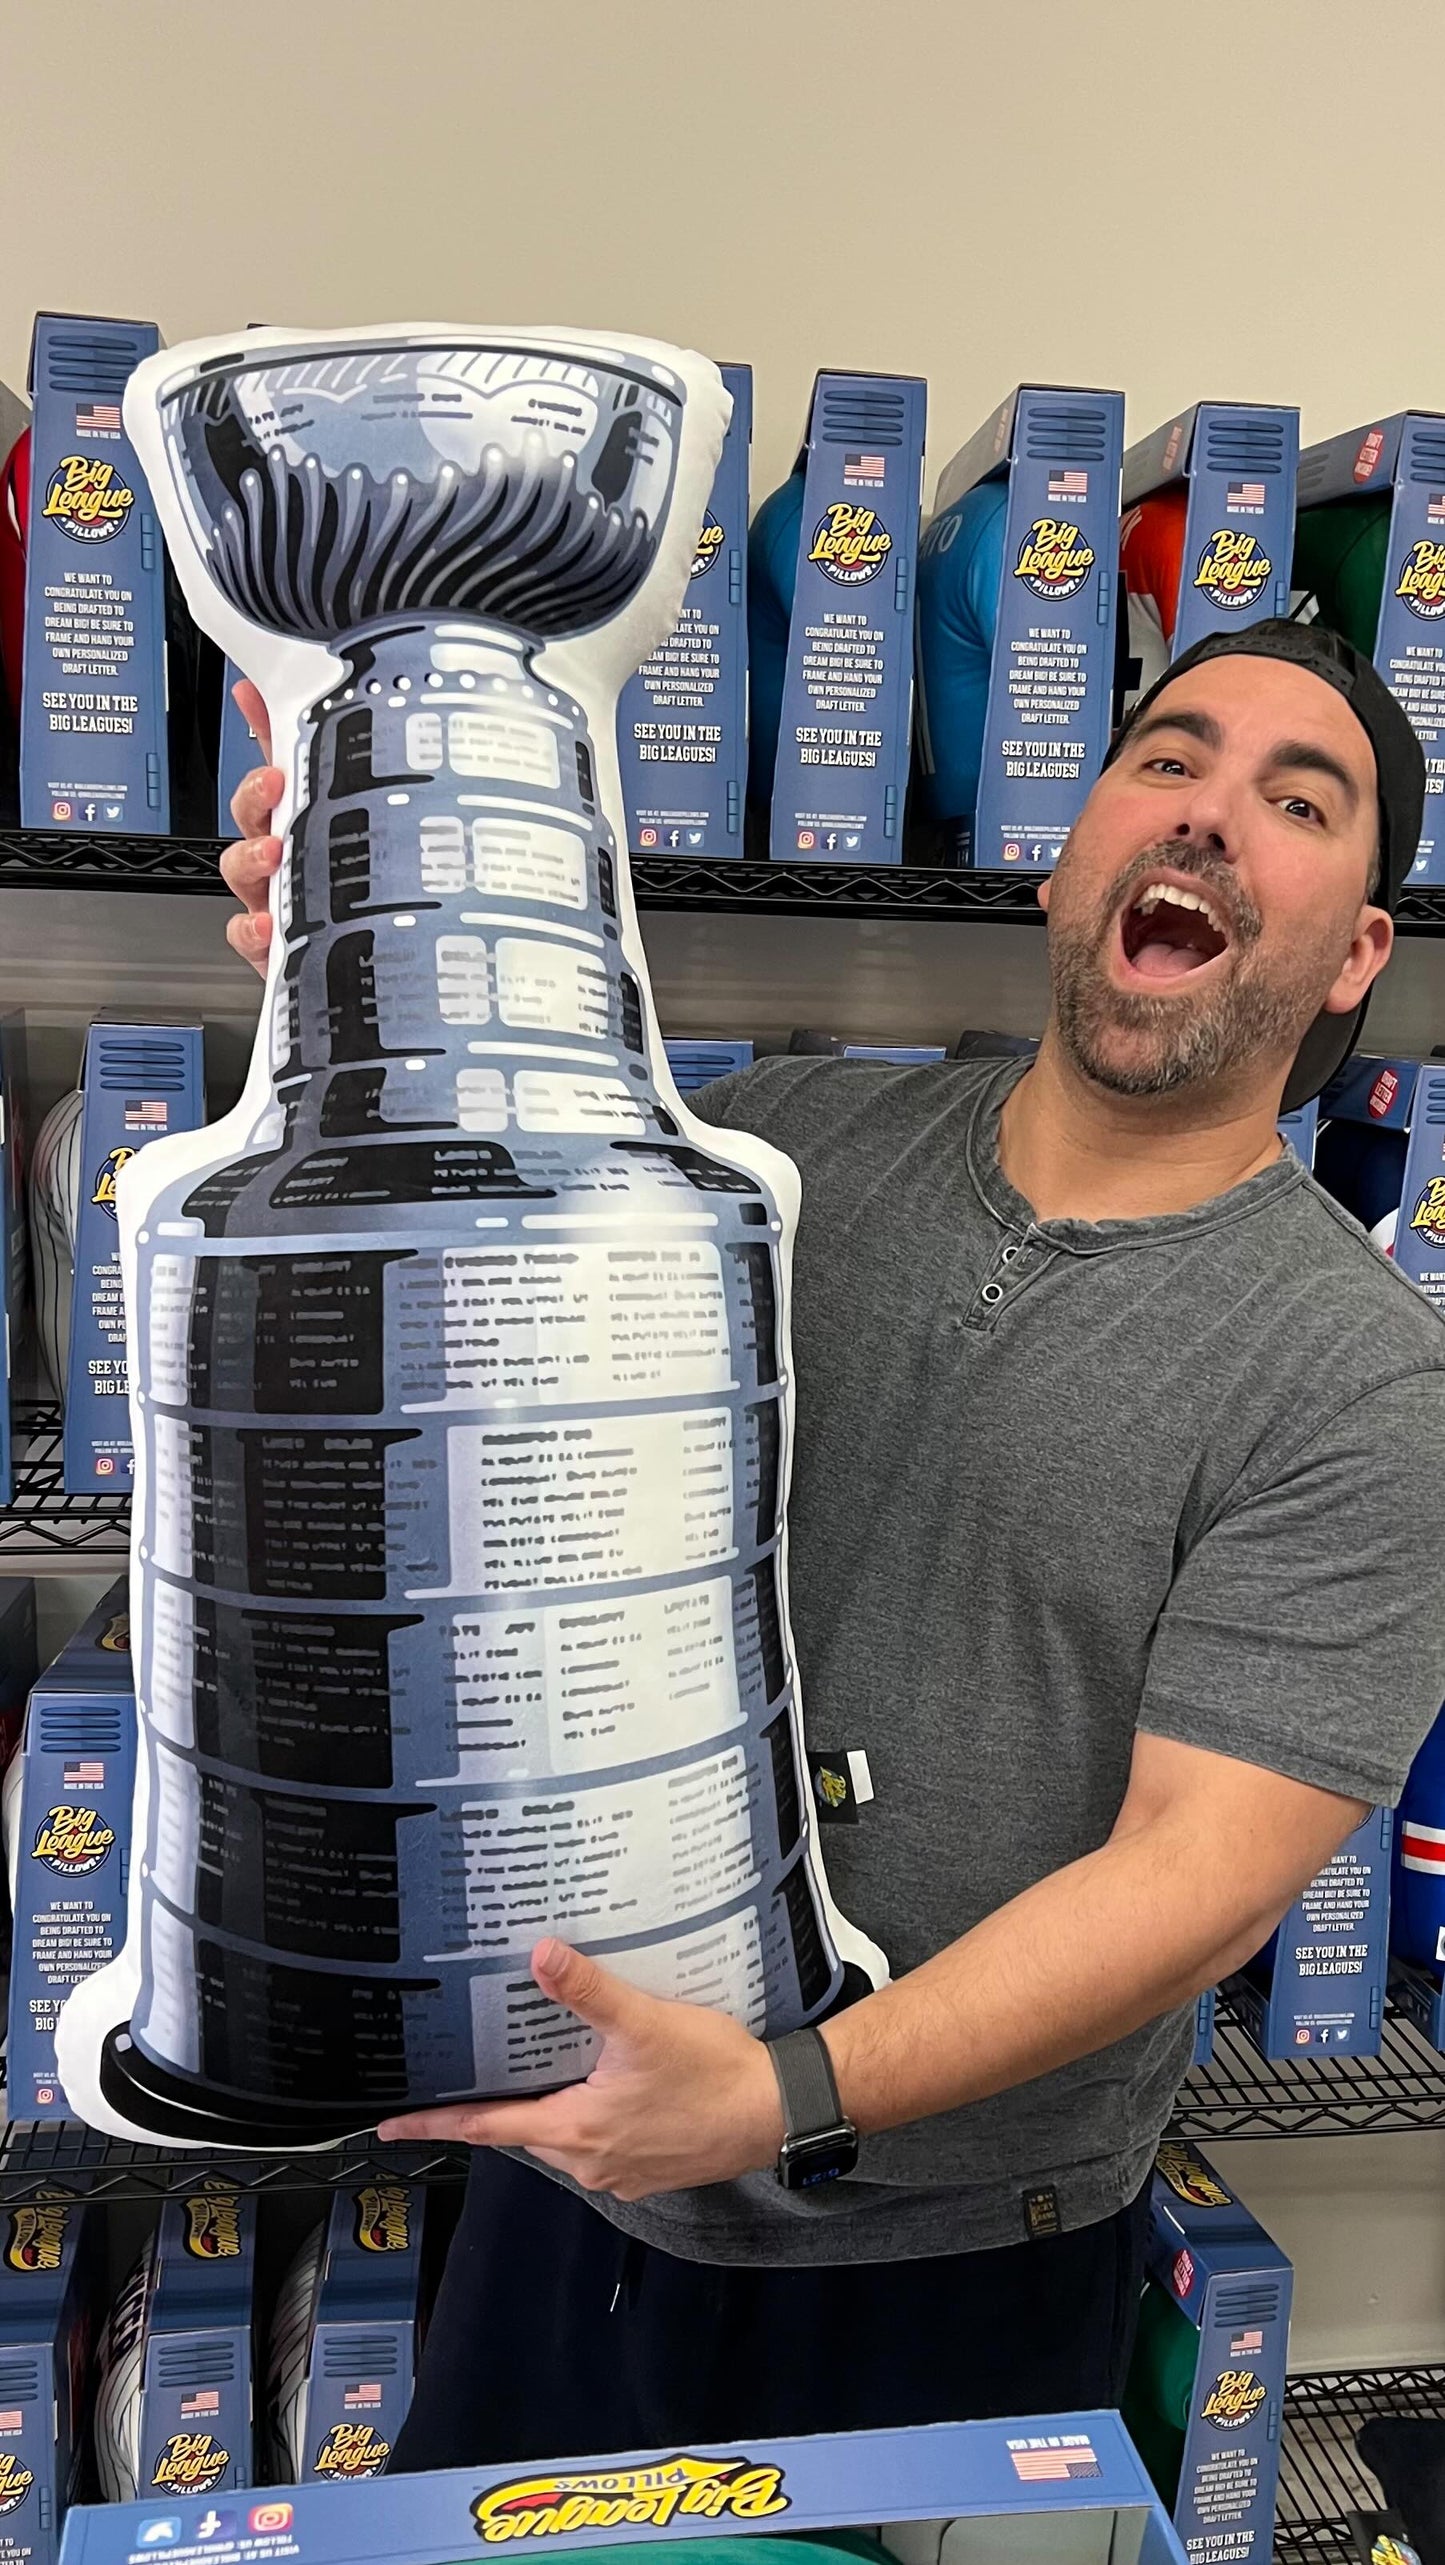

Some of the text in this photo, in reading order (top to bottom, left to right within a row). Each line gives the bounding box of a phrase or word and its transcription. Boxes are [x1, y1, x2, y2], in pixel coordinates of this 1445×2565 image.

[60, 456, 113, 492] Big
[42, 483, 134, 521] League
[828, 503, 875, 537] Big
[65, 521, 114, 537] PILLOWS
[1033, 519, 1078, 553] Big
[808, 529, 891, 564] League
[1212, 530, 1256, 563] Big
[1014, 545, 1094, 579] League
[64, 572, 112, 585] WE WANT TO
[828, 565, 872, 580] PILLOWS
[1194, 556, 1271, 589] League
[45, 587, 132, 601] CONGRATULATE YOU ON
[1033, 580, 1075, 595] PILLOWS
[1212, 590, 1253, 604] PILLOWS
[53, 602, 124, 616] BEING DRAFTED TO
[692, 609, 701, 619] TO
[44, 617, 134, 631] DREAM BIG! BE SURE TO
[824, 613, 866, 625] WE WANT TO
[694, 625, 719, 634] YOU ON
[805, 627, 883, 640] CONGRATULATE YOU ON
[45, 632, 134, 646] FRAME AND HANG YOUR
[670, 638, 712, 649] DRAFTED TO
[52, 647, 128, 661] OWN PERSONALIZED
[812, 642, 875, 655] BEING DRAFTED TO
[665, 652, 720, 664] BIG! BE SURE TO
[803, 656, 883, 669] DREAM BIG! BE SURE TO
[62, 663, 118, 675] DRAFT LETTER.
[639, 665, 720, 678] FRAME AND HANG YOUR
[803, 670, 882, 684] FRAME AND HANG YOUR
[644, 680, 714, 692] OWN PERSONALIZED
[808, 685, 876, 698] OWN PERSONALIZED
[42, 692, 138, 712] SEE YOU IN THE
[653, 695, 704, 706] DRAFT LETTER.
[816, 700, 866, 712] DRAFT LETTER.
[49, 715, 133, 733] BIG LEAGUES!
[634, 723, 721, 741] SEE YOU IN THE
[796, 727, 881, 746] SEE YOU IN THE
[639, 745, 716, 762] BIG LEAGUES!
[1002, 741, 1084, 757] SEE YOU IN THE
[801, 748, 875, 766] BIG LEAGUES!
[1007, 762, 1079, 778] BIG LEAGUES!
[88, 1360, 128, 1374] SEE YO
[94, 1380, 115, 1394] BIG
[49, 1806, 96, 1835] Big
[32, 1829, 114, 1858] League
[52, 1858, 96, 1872] PILLOWS
[1296, 1945, 1368, 1959] SEE YOU IN THE
[1299, 1962, 1363, 1975] BIG LEAGUES!
[29, 2001, 51, 2013] SEE
[35, 2018, 54, 2030] BIG
[209, 2204, 243, 2256] League
[379, 2198, 412, 2249] League
[1217, 2371, 1254, 2396] Big
[1201, 2386, 1266, 2417] League
[330, 2423, 374, 2450] Big
[167, 2434, 212, 2462] Big
[314, 2442, 390, 2470] League
[151, 2450, 229, 2484] League
[170, 2478, 212, 2493] PILLOWS
[554, 2468, 689, 2491] PILLOWS
[480, 2468, 788, 2542] Big League
[1187, 2531, 1254, 2550] SEE YOU IN THE
[1206, 2547, 1249, 2562] LEAGUES!
